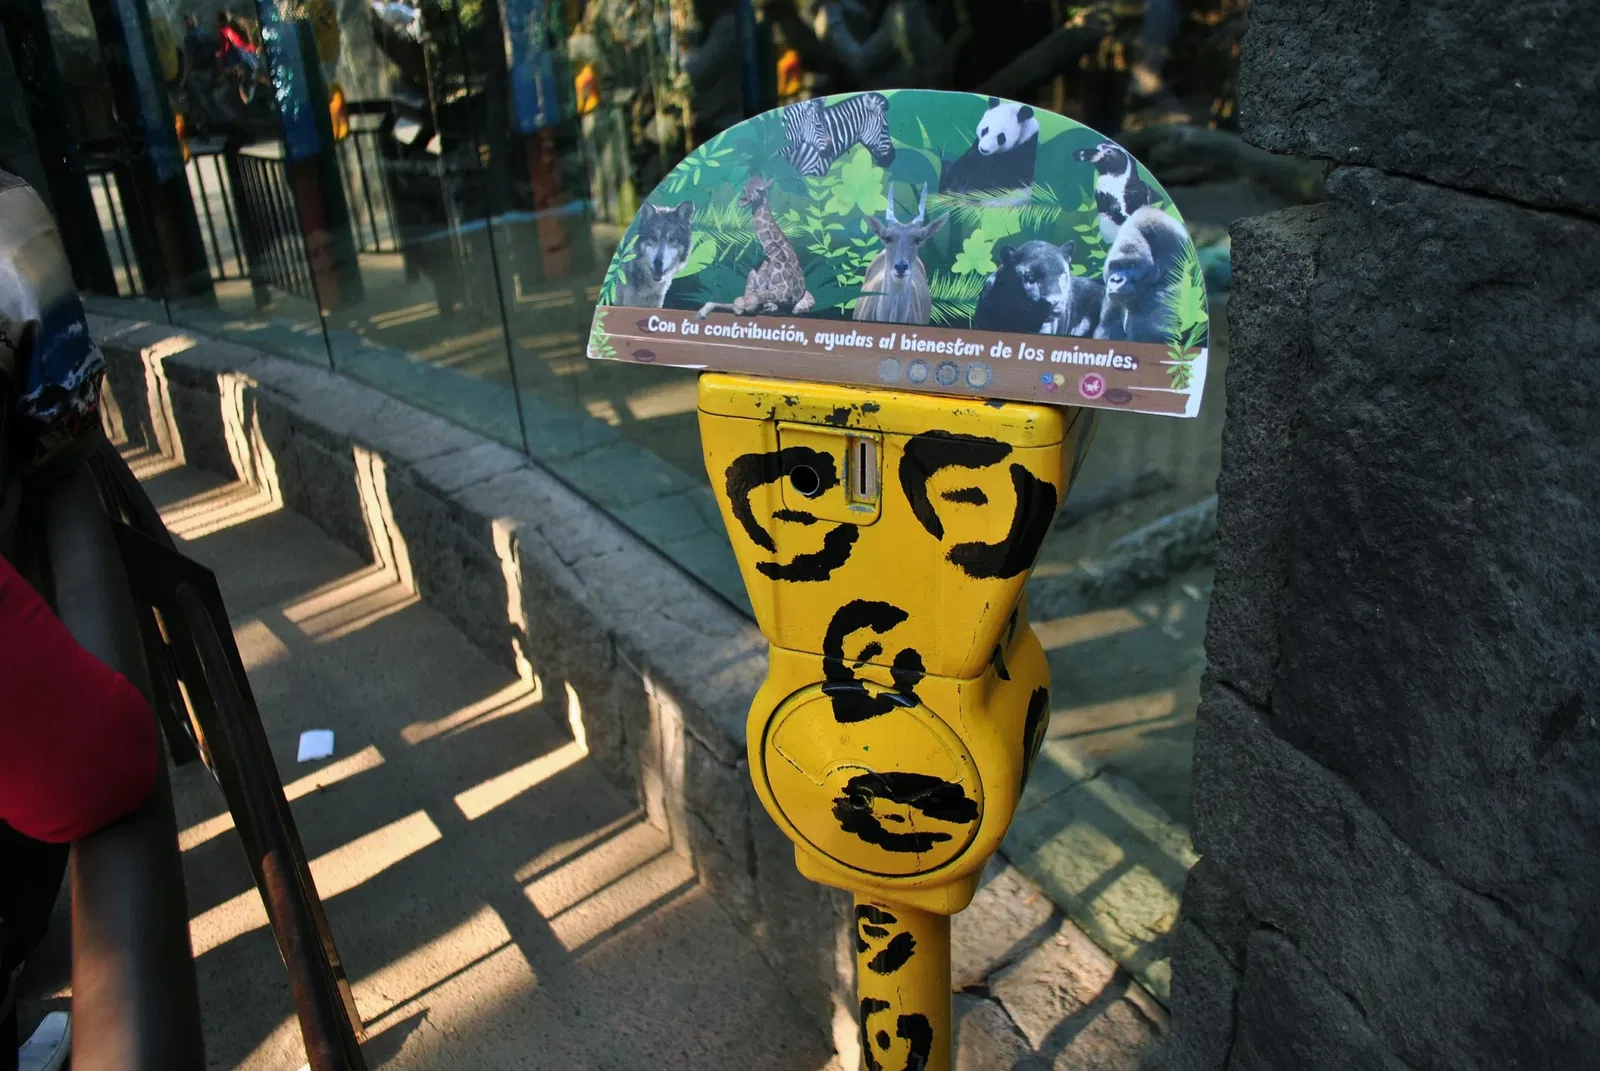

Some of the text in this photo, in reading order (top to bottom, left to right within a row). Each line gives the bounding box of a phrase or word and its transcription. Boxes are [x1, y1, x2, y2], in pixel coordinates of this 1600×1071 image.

[648, 315, 676, 333] Con
[681, 318, 699, 335] tu
[704, 323, 808, 346] contribución,
[815, 329, 873, 350] ayudas
[879, 332, 896, 349] al
[901, 333, 984, 357] bienestar
[990, 341, 1013, 359] de
[1018, 343, 1045, 361] los
